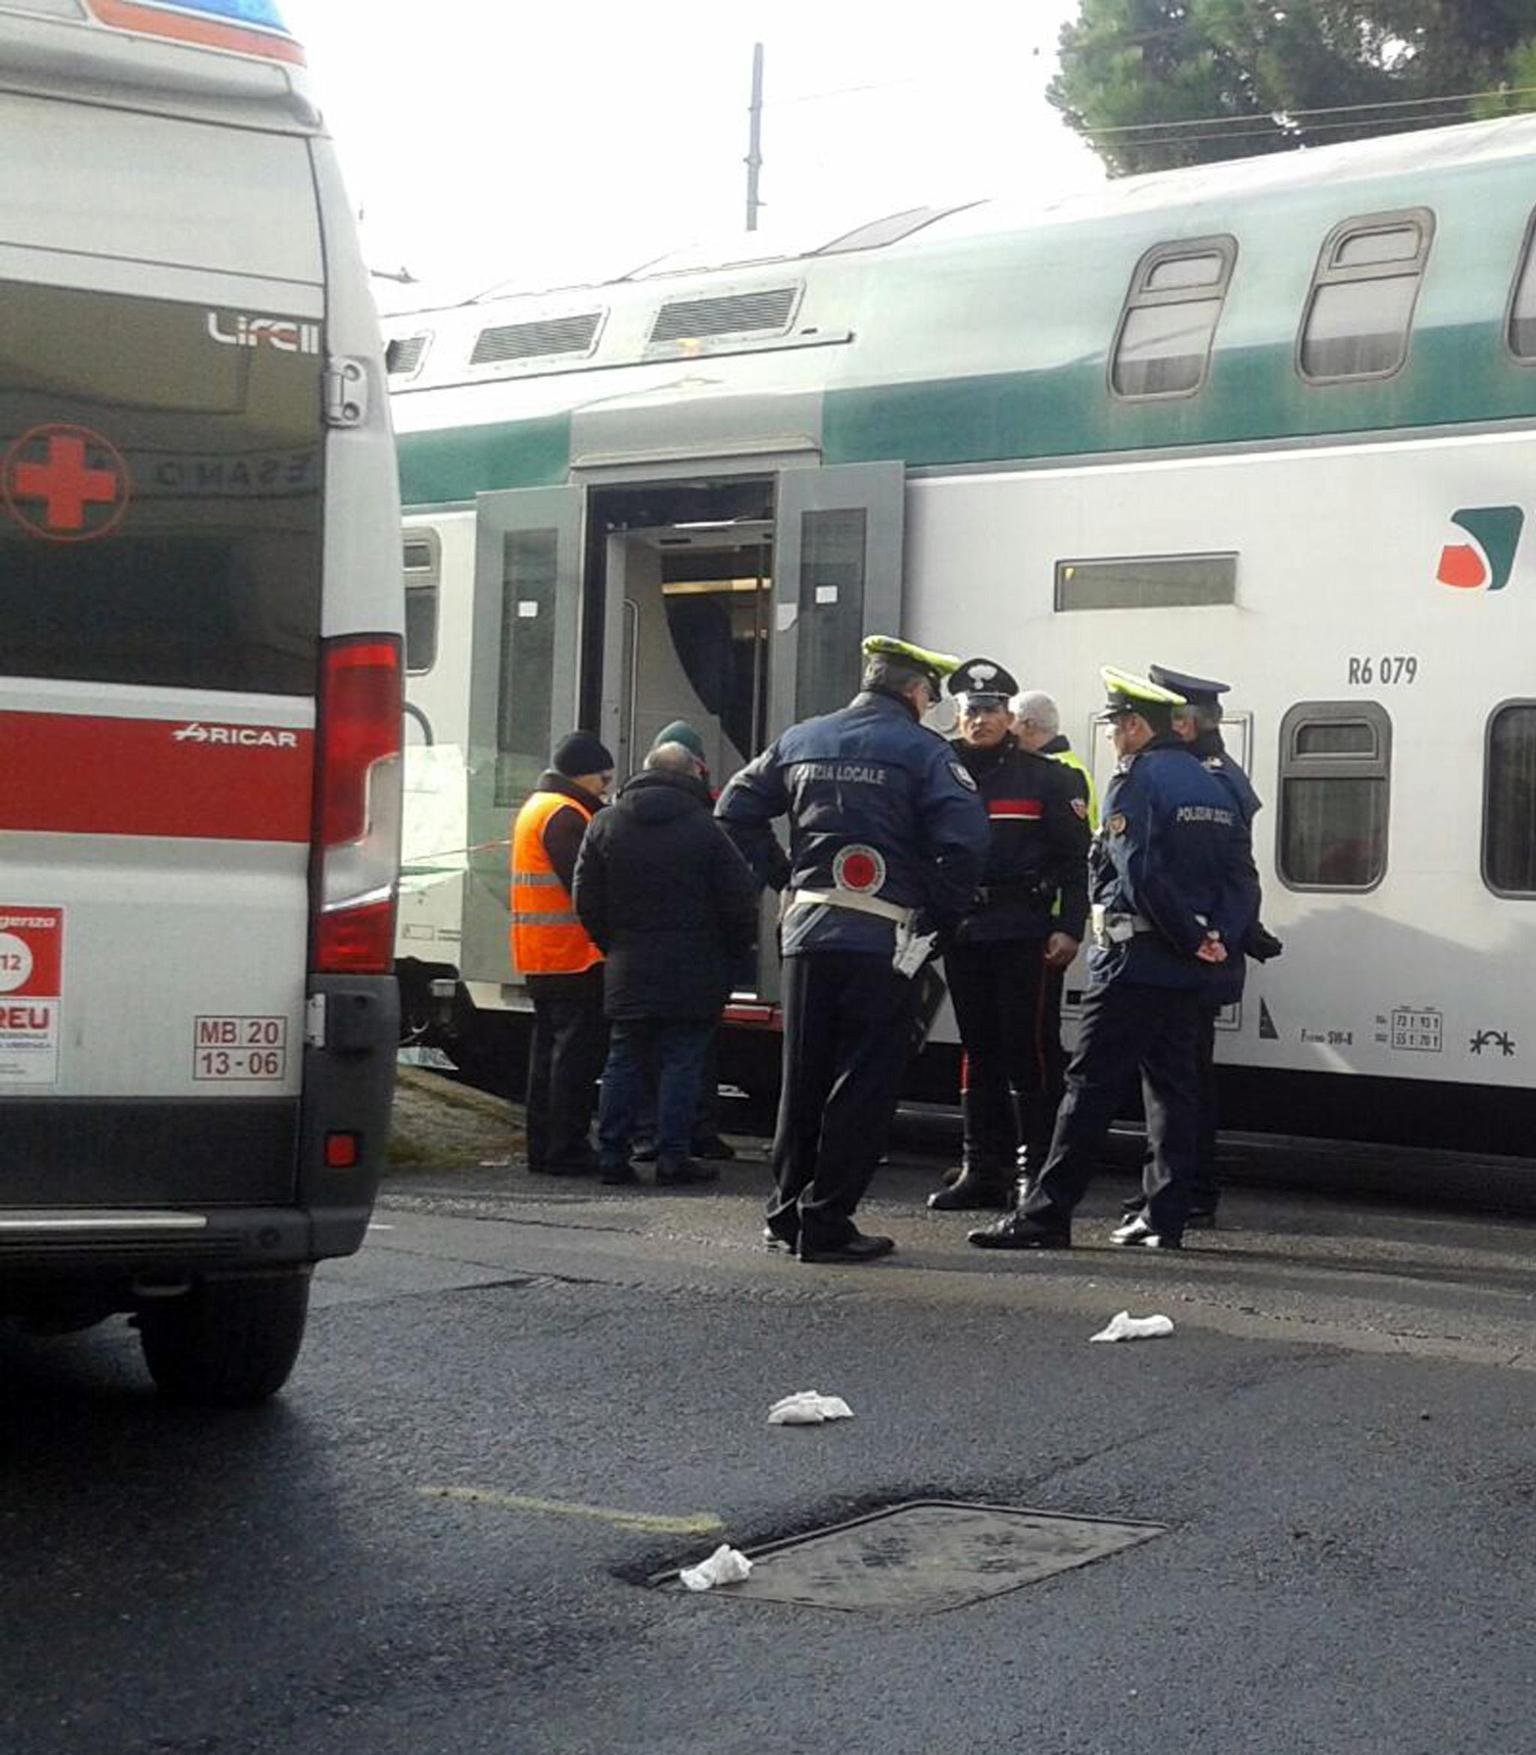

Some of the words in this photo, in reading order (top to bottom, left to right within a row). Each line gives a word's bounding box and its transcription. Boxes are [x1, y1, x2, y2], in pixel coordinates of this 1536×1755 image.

[1349, 657, 1373, 684] R6
[1380, 656, 1417, 684] 079
[836, 765, 887, 785] LOCALE
[200, 1021, 238, 1044] MB
[248, 1021, 280, 1044] 20
